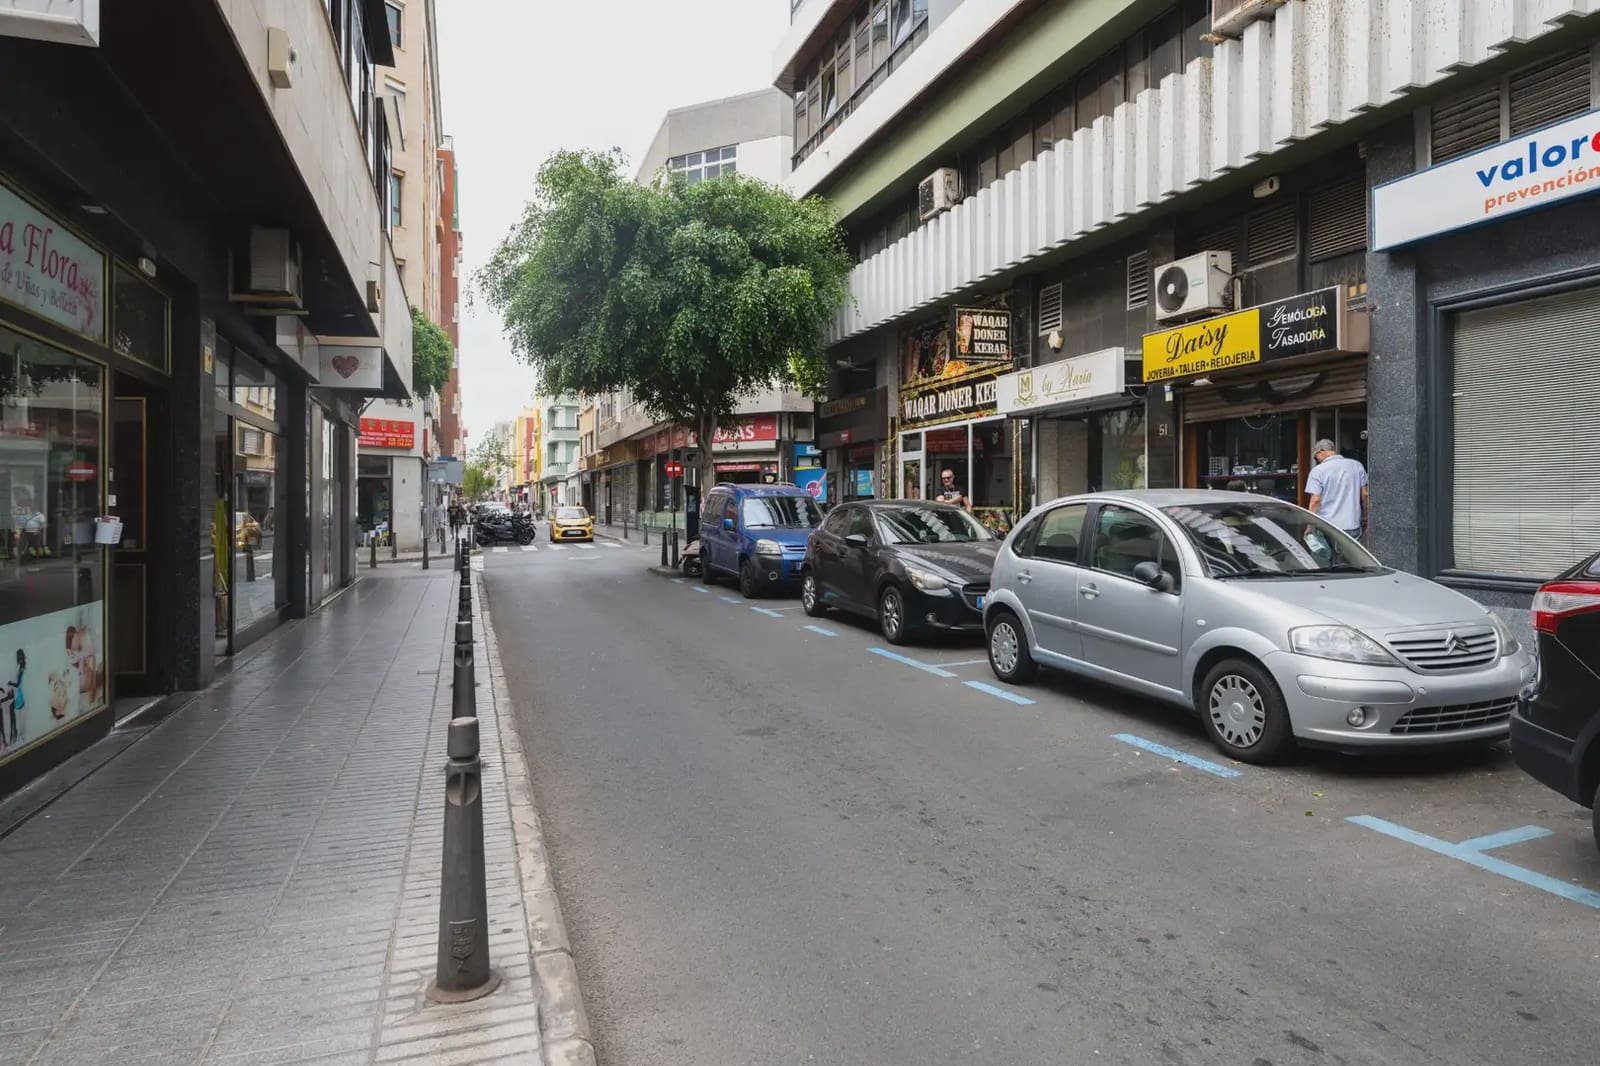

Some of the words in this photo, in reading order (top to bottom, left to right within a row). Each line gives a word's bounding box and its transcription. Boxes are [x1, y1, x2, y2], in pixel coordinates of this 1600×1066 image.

[1485, 166, 1600, 214] prevención
[23, 223, 78, 291] Flora
[16, 270, 41, 296] Uñas
[972, 314, 1009, 328] WAQAR
[1267, 305, 1328, 328] GEMÓLOGA
[973, 328, 1007, 341] DONER
[1166, 323, 1229, 363] Daisy
[1268, 327, 1327, 350] TASADORA
[973, 342, 1007, 354] KEBAB
[1147, 366, 1175, 381] JOYERIA
[1179, 359, 1207, 374] TALLER
[1210, 350, 1257, 369] RELOJERIA
[904, 394, 937, 419] WAQAR
[938, 385, 974, 412] DONER
